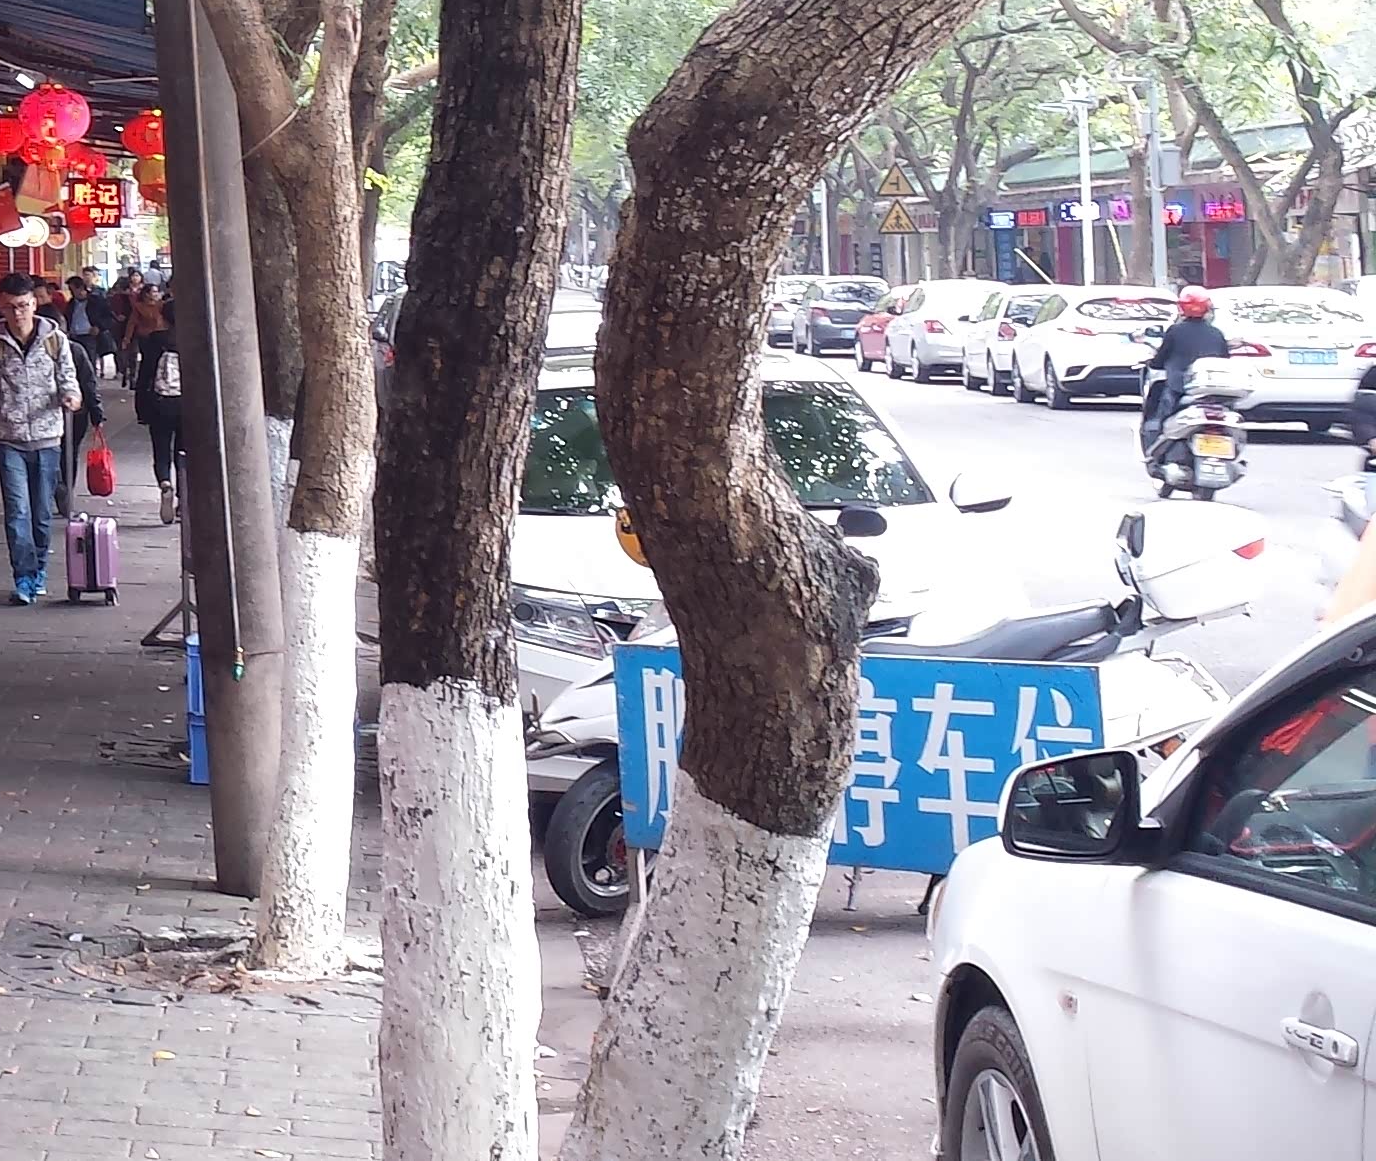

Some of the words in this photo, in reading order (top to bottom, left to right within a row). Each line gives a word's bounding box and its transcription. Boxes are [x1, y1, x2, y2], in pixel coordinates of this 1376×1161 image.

[72, 182, 119, 205] 胜记
[89, 208, 119, 224] 号厅
[641, 667, 1093, 854] 停车位
